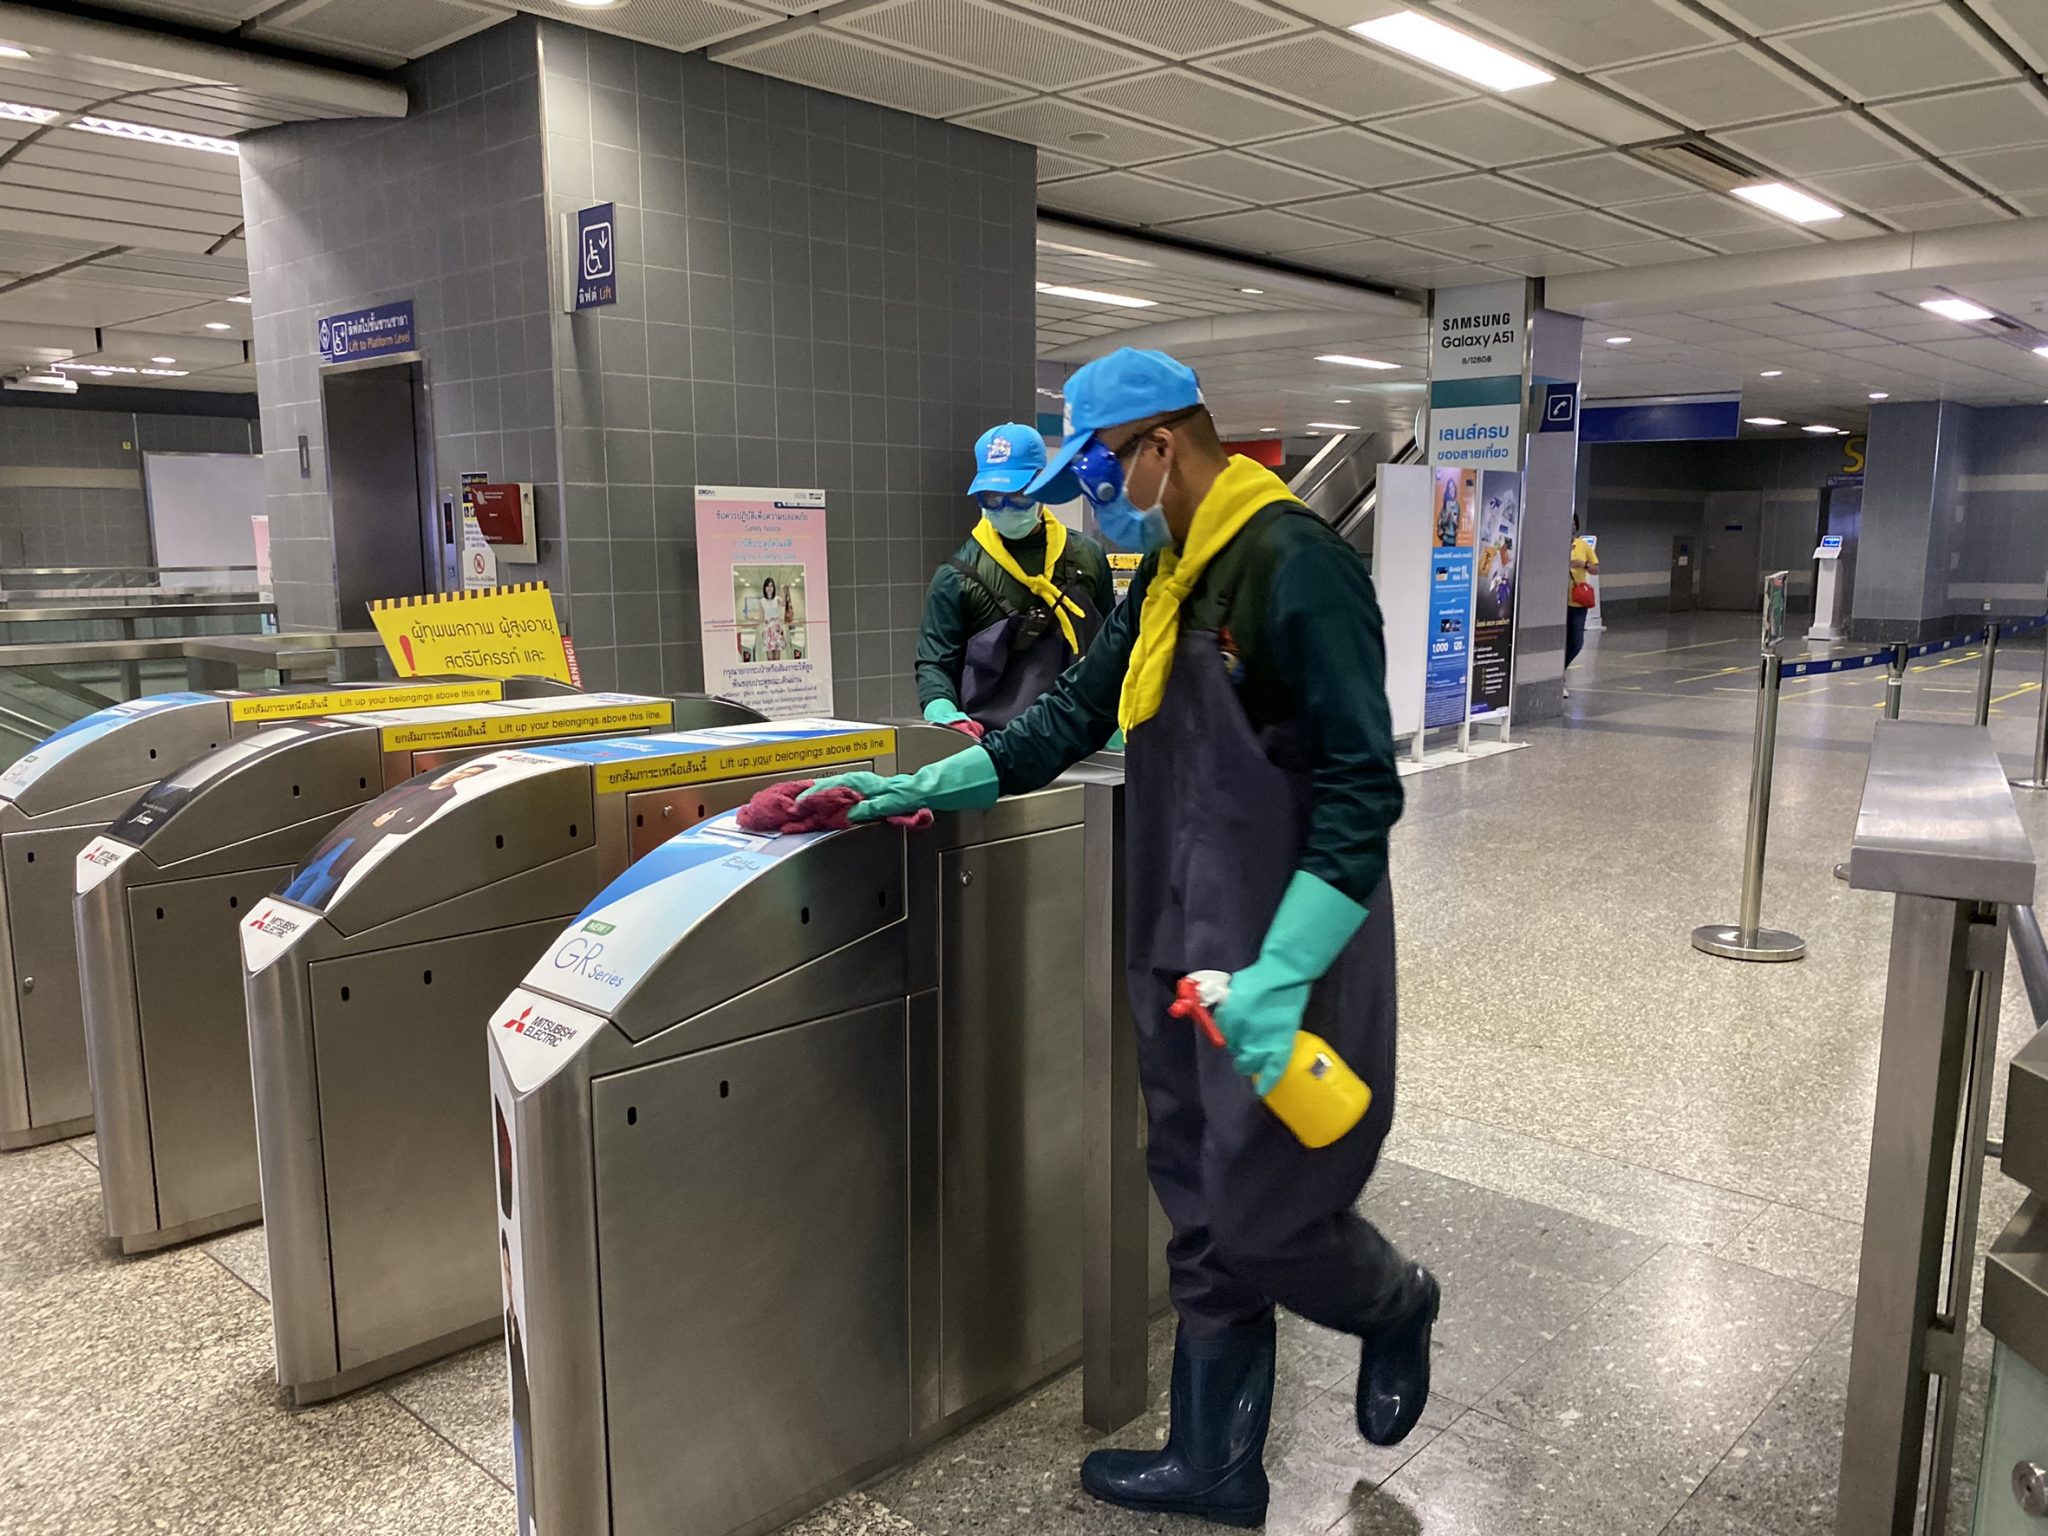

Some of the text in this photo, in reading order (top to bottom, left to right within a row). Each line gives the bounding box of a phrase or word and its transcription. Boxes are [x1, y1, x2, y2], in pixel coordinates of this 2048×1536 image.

[599, 285, 612, 300] Lift
[1442, 312, 1511, 331] SAMSUNG
[367, 335, 394, 349] Platform
[394, 330, 411, 344] Level
[1441, 330, 1514, 349] Galaxy A51
[1439, 422, 1509, 441] เลนส์ครบ
[1437, 443, 1509, 460] ของสายเที่ยว
[499, 616, 555, 639] ผู้สูงอายุ
[444, 646, 546, 669] สตรีมีครรภ์ และ
[563, 640, 582, 688] ARNING!!
[339, 698, 352, 708] Lift
[355, 698, 366, 707] up
[368, 697, 386, 707] your
[389, 693, 433, 704] belongings
[435, 690, 460, 699] above
[461, 689, 476, 698] this
[499, 724, 513, 734] Lift
[515, 722, 528, 732] up
[530, 721, 549, 732] your
[552, 717, 599, 728] belongings
[602, 713, 627, 724] above
[629, 712, 644, 721] this
[719, 757, 735, 770] Lift
[737, 757, 749, 769] up
[752, 754, 773, 767] your
[775, 747, 823, 762] belongings
[826, 743, 852, 755] above
[853, 741, 868, 751] this
[554, 937, 625, 987] GR Series
[523, 1025, 563, 1048] ELECTRIC
[531, 1015, 578, 1041] MITSUBISHI
